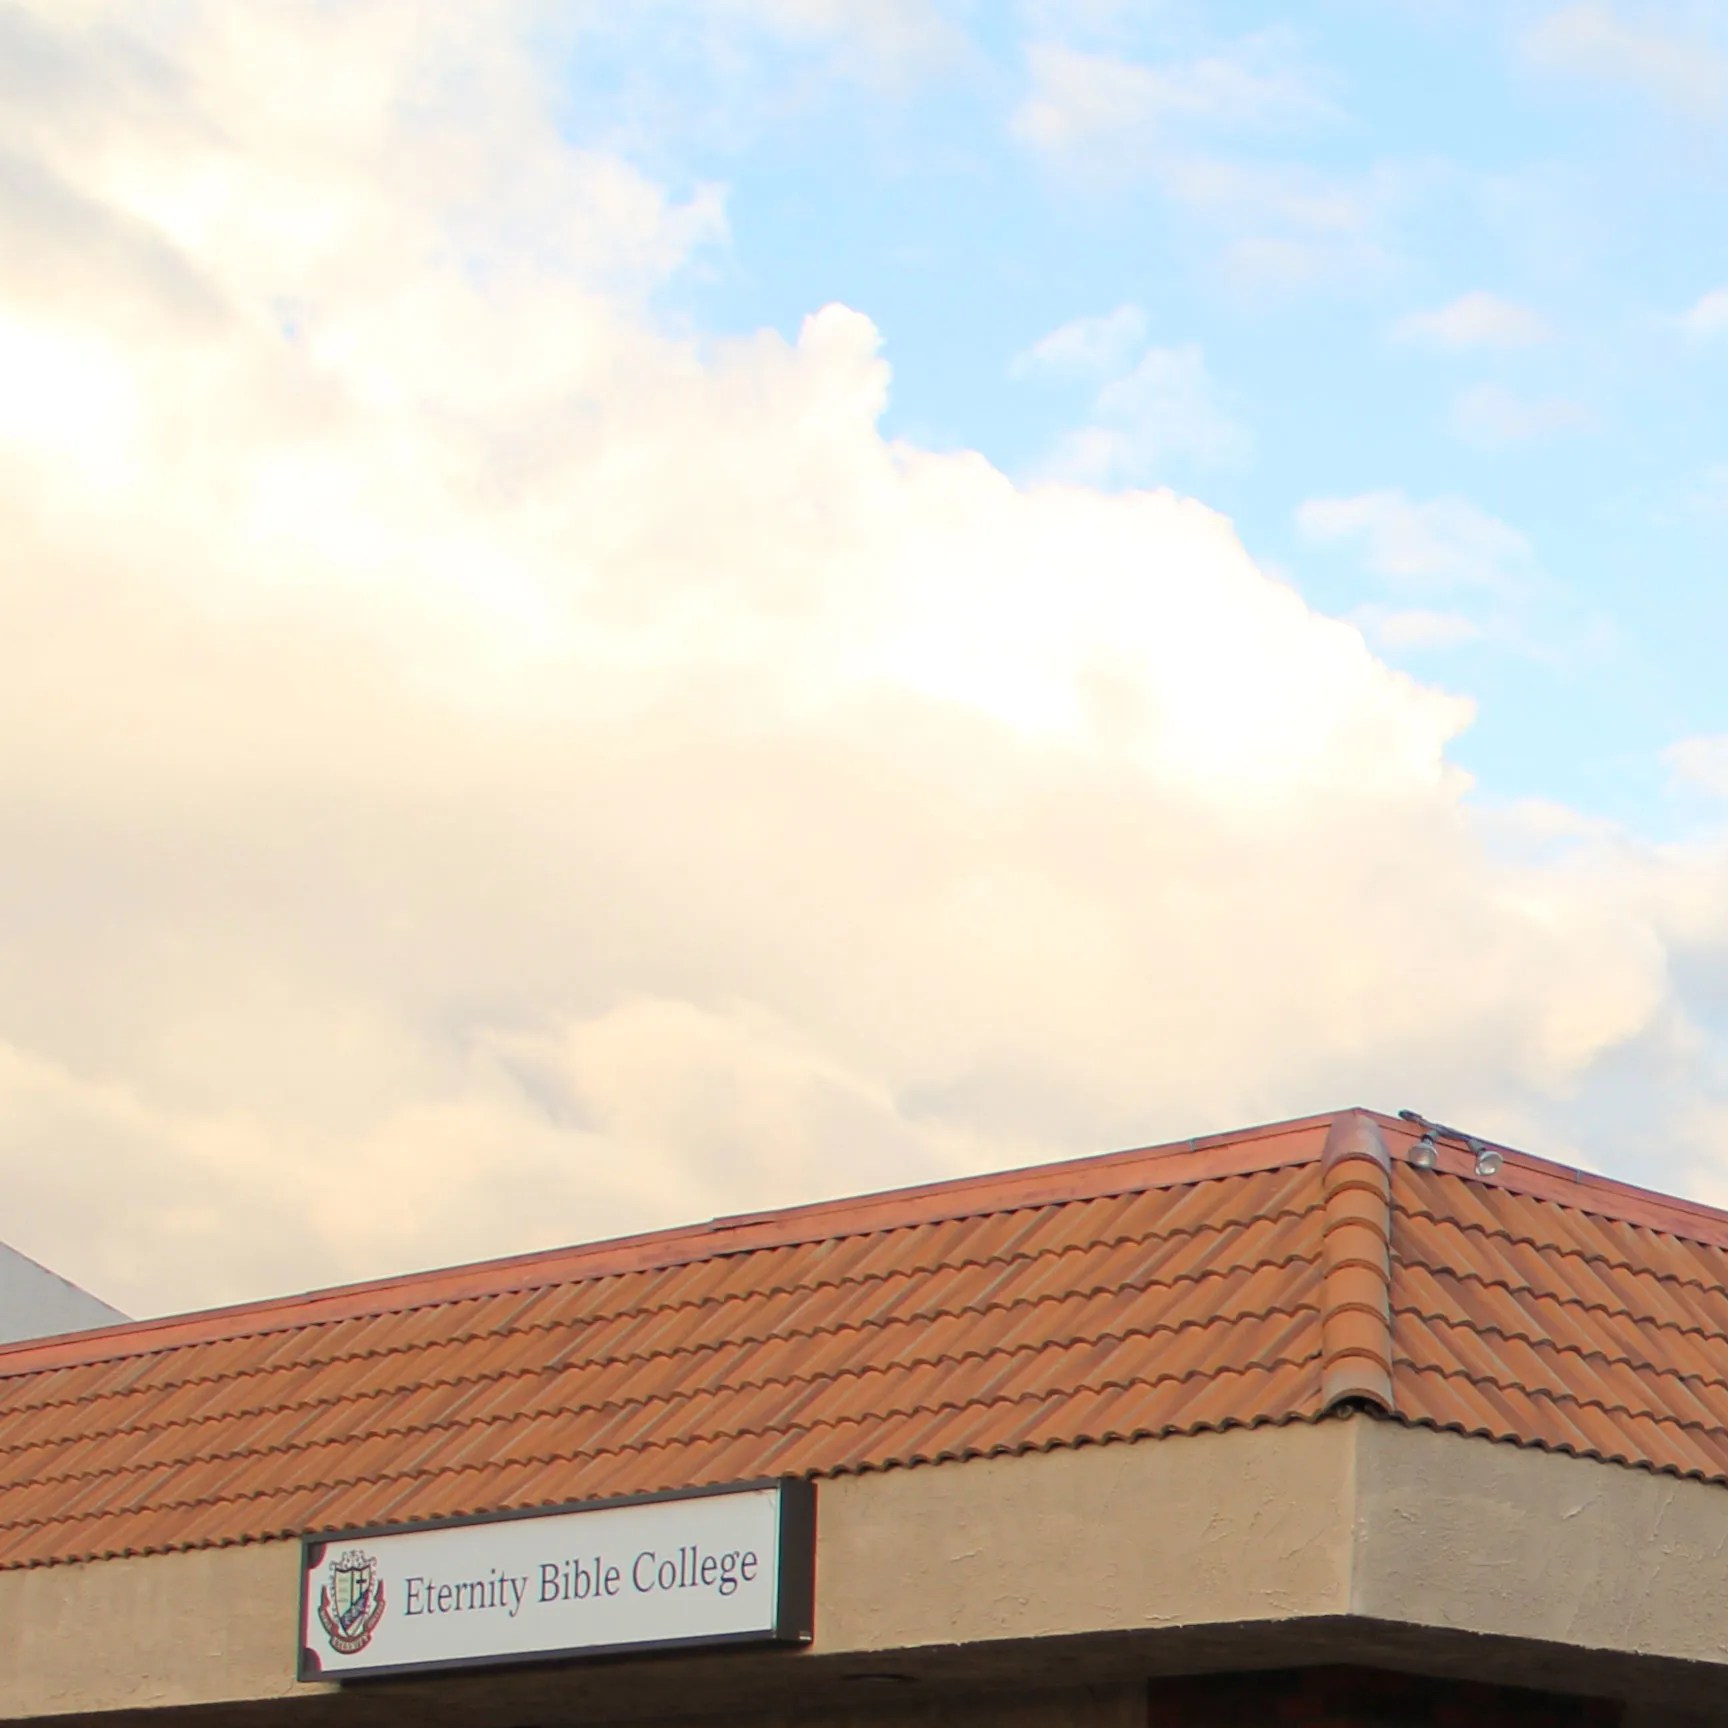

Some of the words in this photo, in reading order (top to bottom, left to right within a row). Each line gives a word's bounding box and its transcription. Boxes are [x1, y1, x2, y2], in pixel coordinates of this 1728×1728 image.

[403, 1568, 528, 1617] Eternity
[537, 1557, 620, 1603] Bible
[632, 1545, 758, 1595] College
